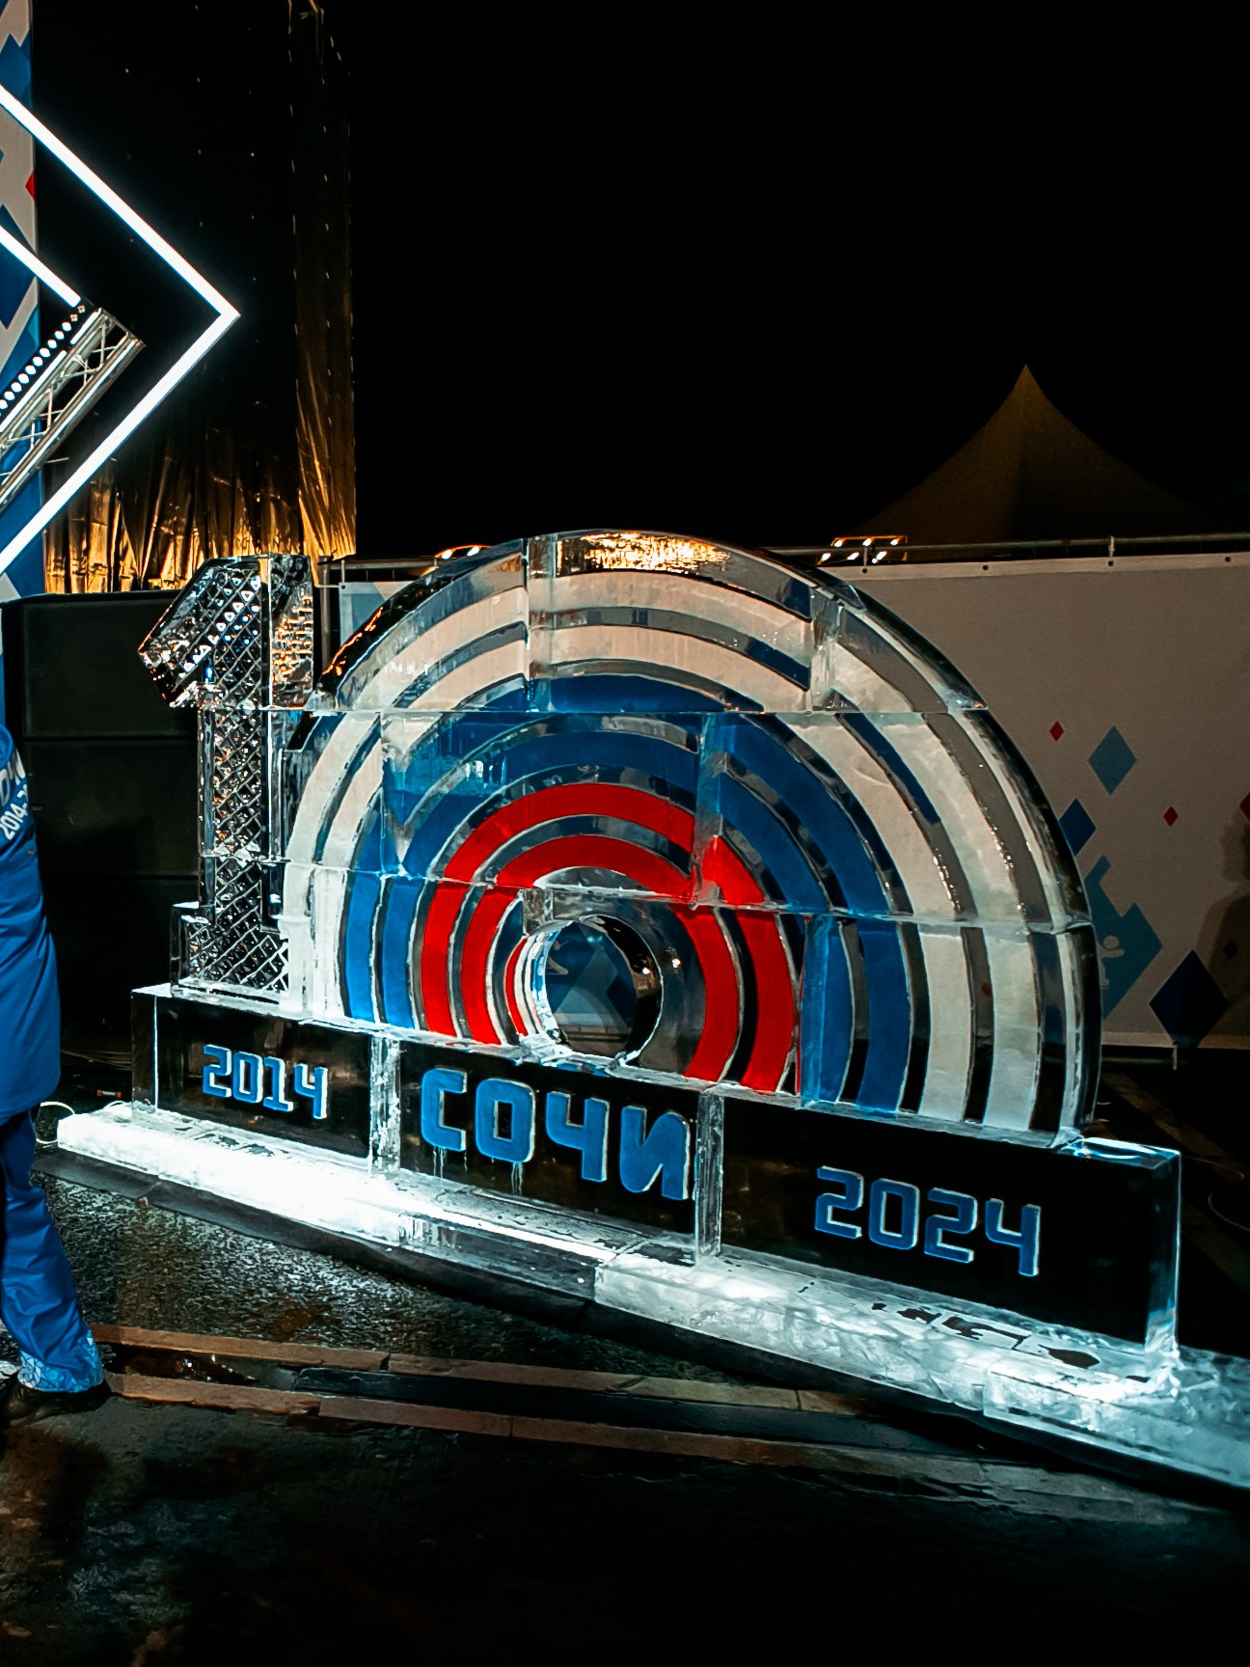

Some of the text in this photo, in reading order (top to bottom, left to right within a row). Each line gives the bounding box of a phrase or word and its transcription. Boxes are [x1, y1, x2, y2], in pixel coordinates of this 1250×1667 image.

[202, 1044, 1042, 1277] 2014 СОЧИ 2024
